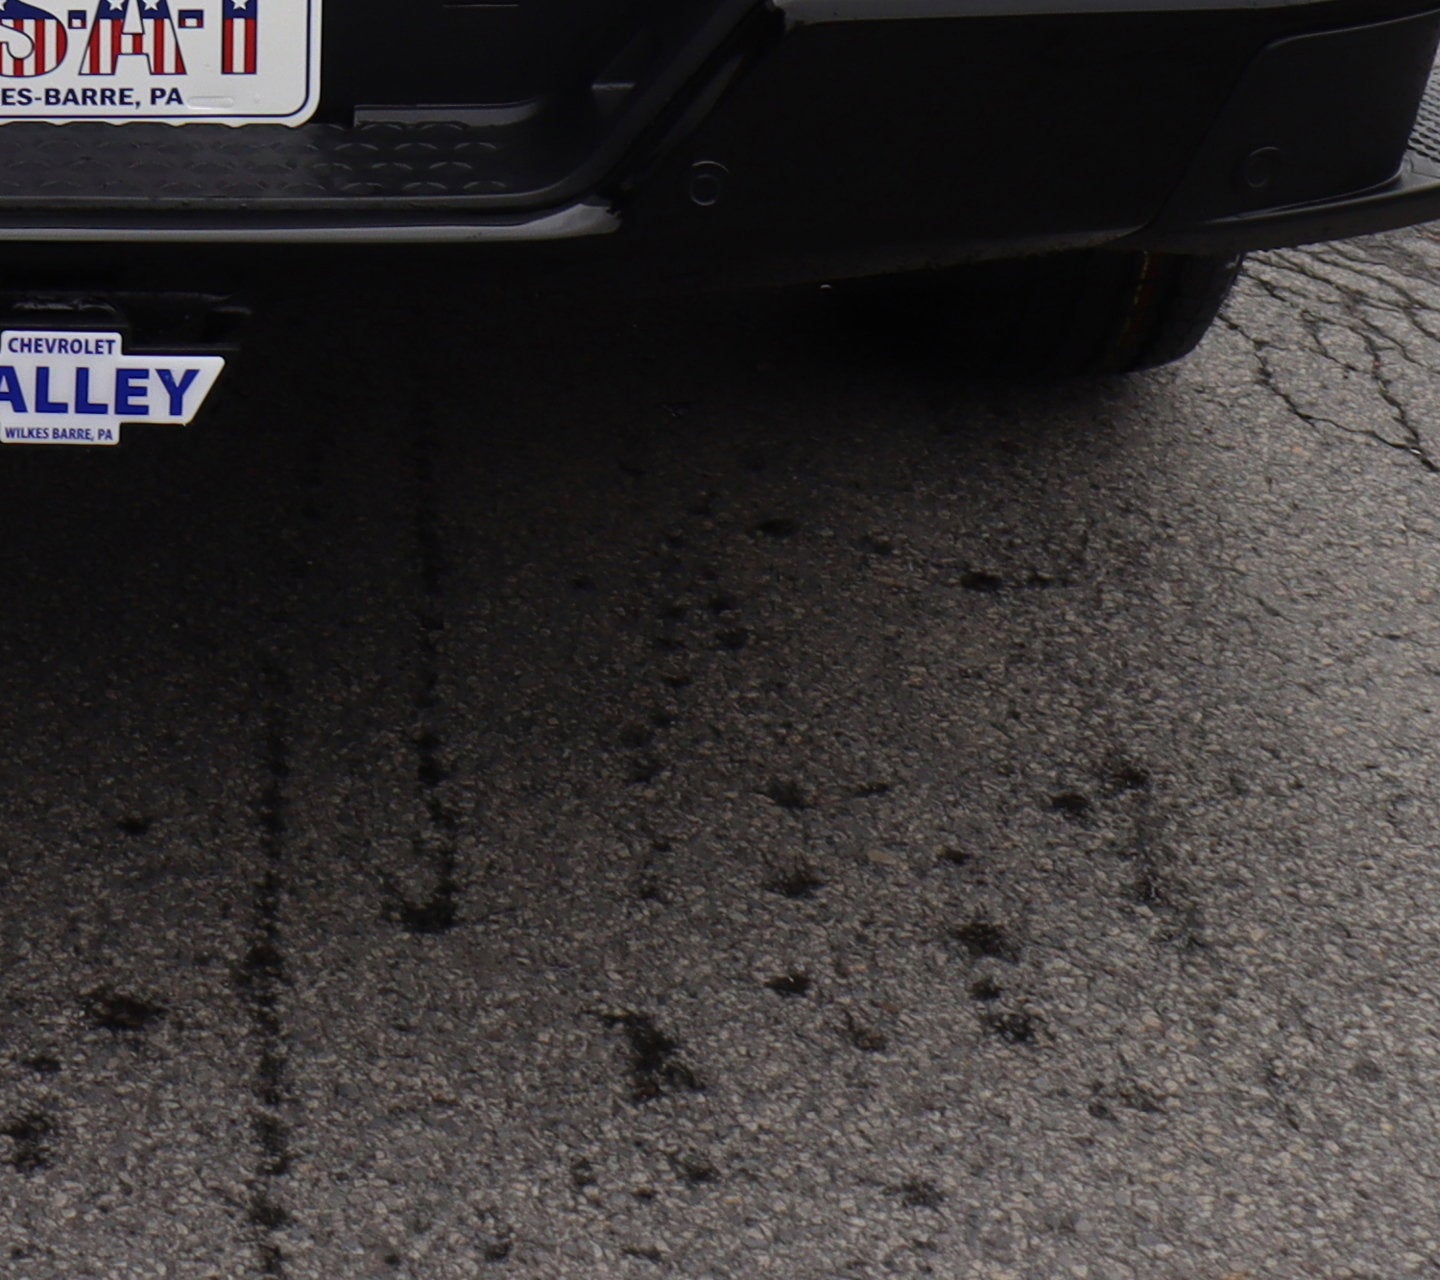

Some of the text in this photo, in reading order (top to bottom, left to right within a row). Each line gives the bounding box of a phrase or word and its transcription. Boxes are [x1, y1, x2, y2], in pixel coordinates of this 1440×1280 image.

[149, 87, 184, 108] PA
[7, 336, 117, 356] CHEVROLET
[4, 426, 114, 443] WILKES BARRE, PA
